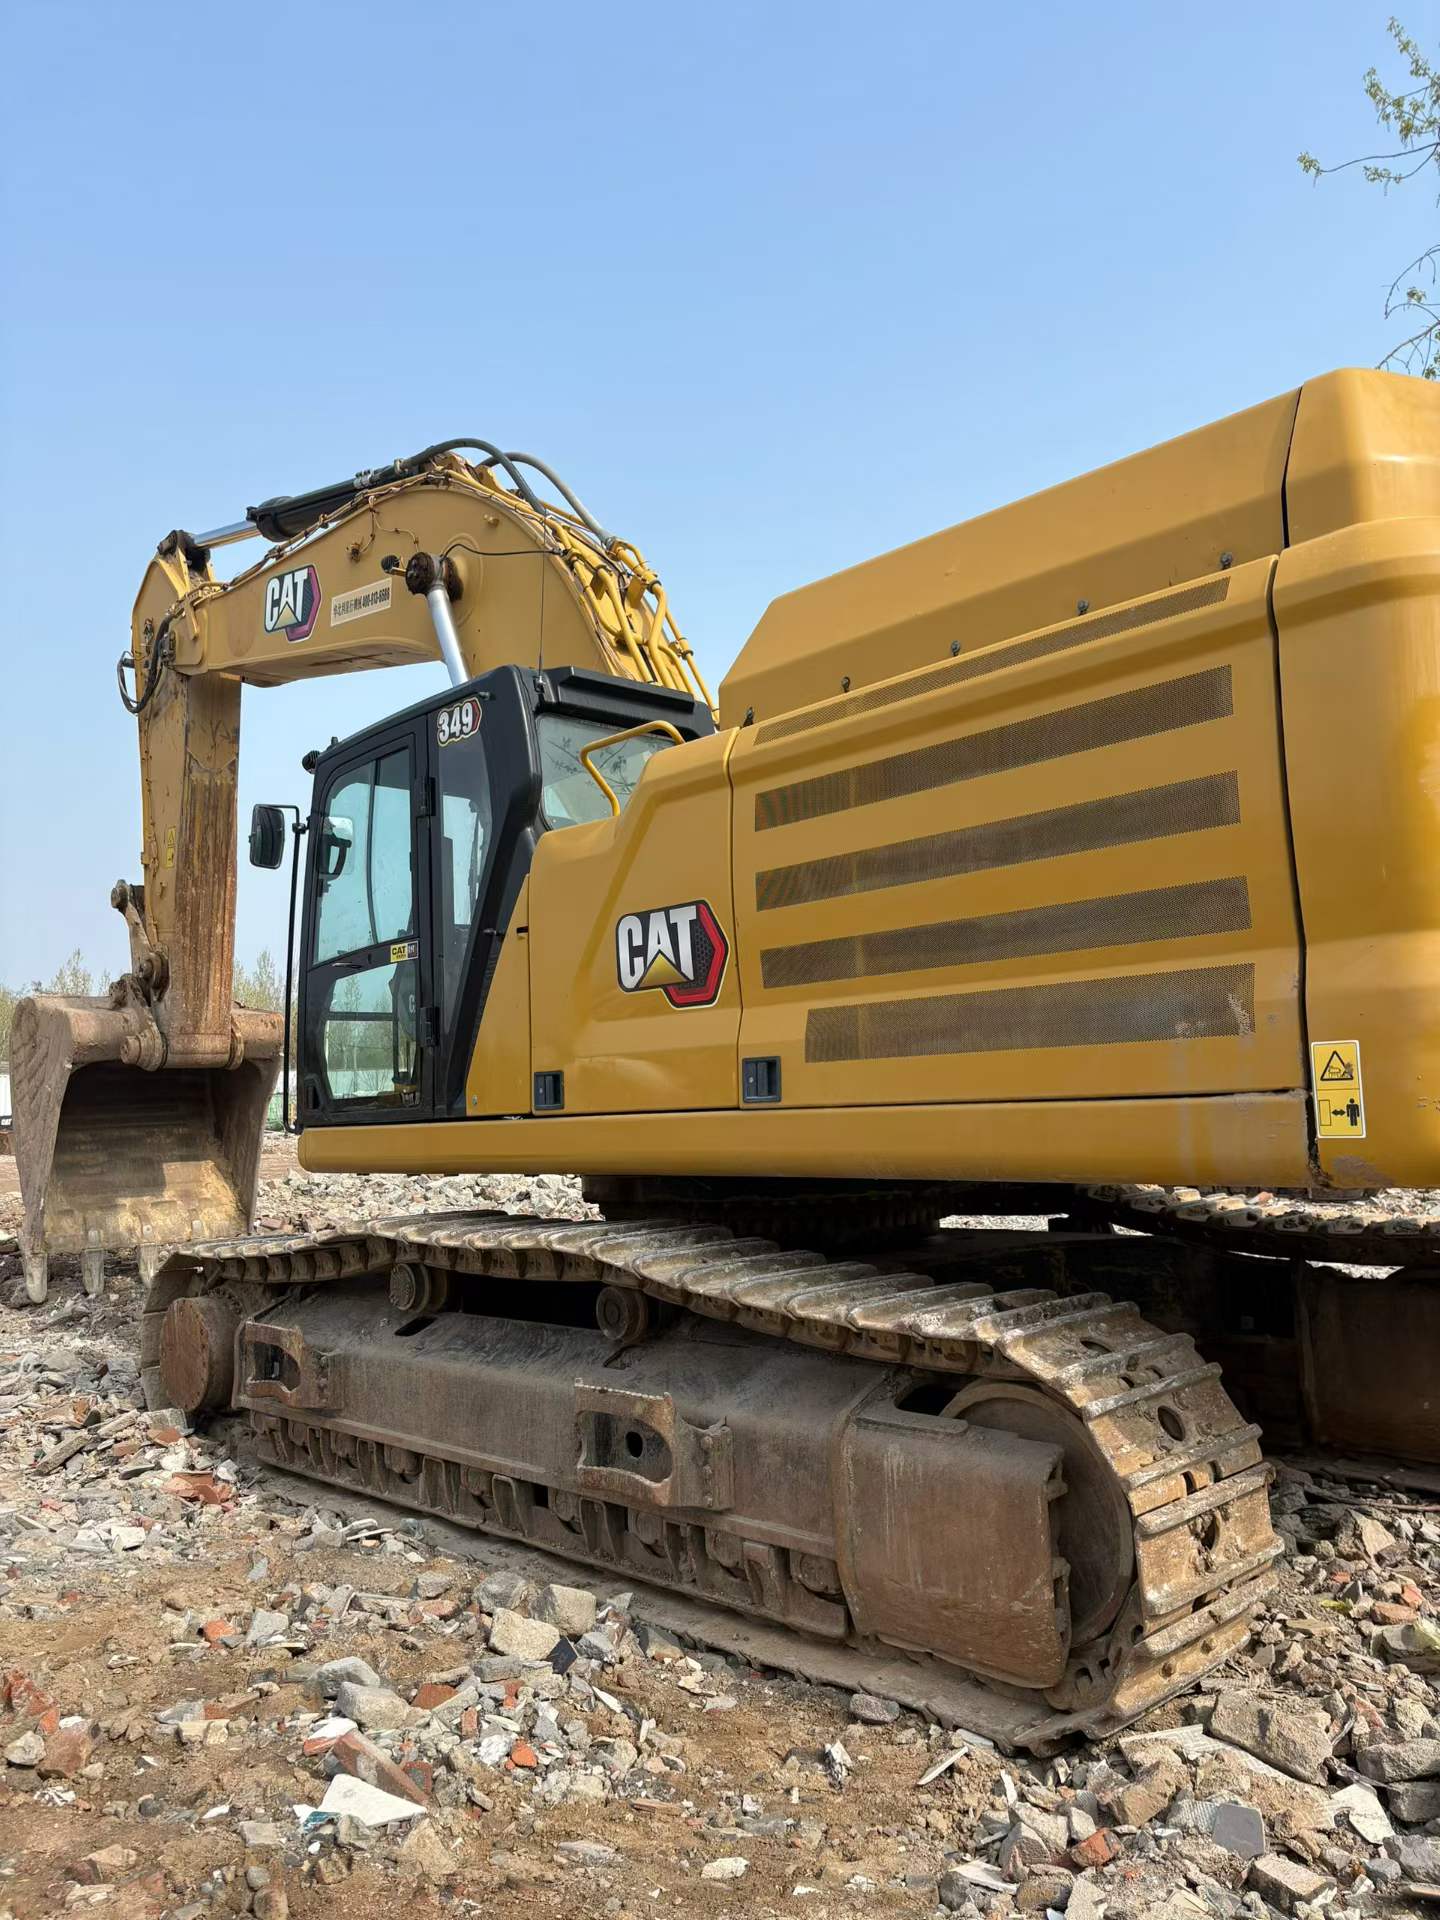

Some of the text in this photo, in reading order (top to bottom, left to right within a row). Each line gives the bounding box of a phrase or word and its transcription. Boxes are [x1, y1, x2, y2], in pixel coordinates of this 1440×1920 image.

[265, 567, 309, 632] CAT
[438, 702, 473, 742] 349
[391, 945, 406, 956] CAT
[617, 905, 697, 989] CAT
